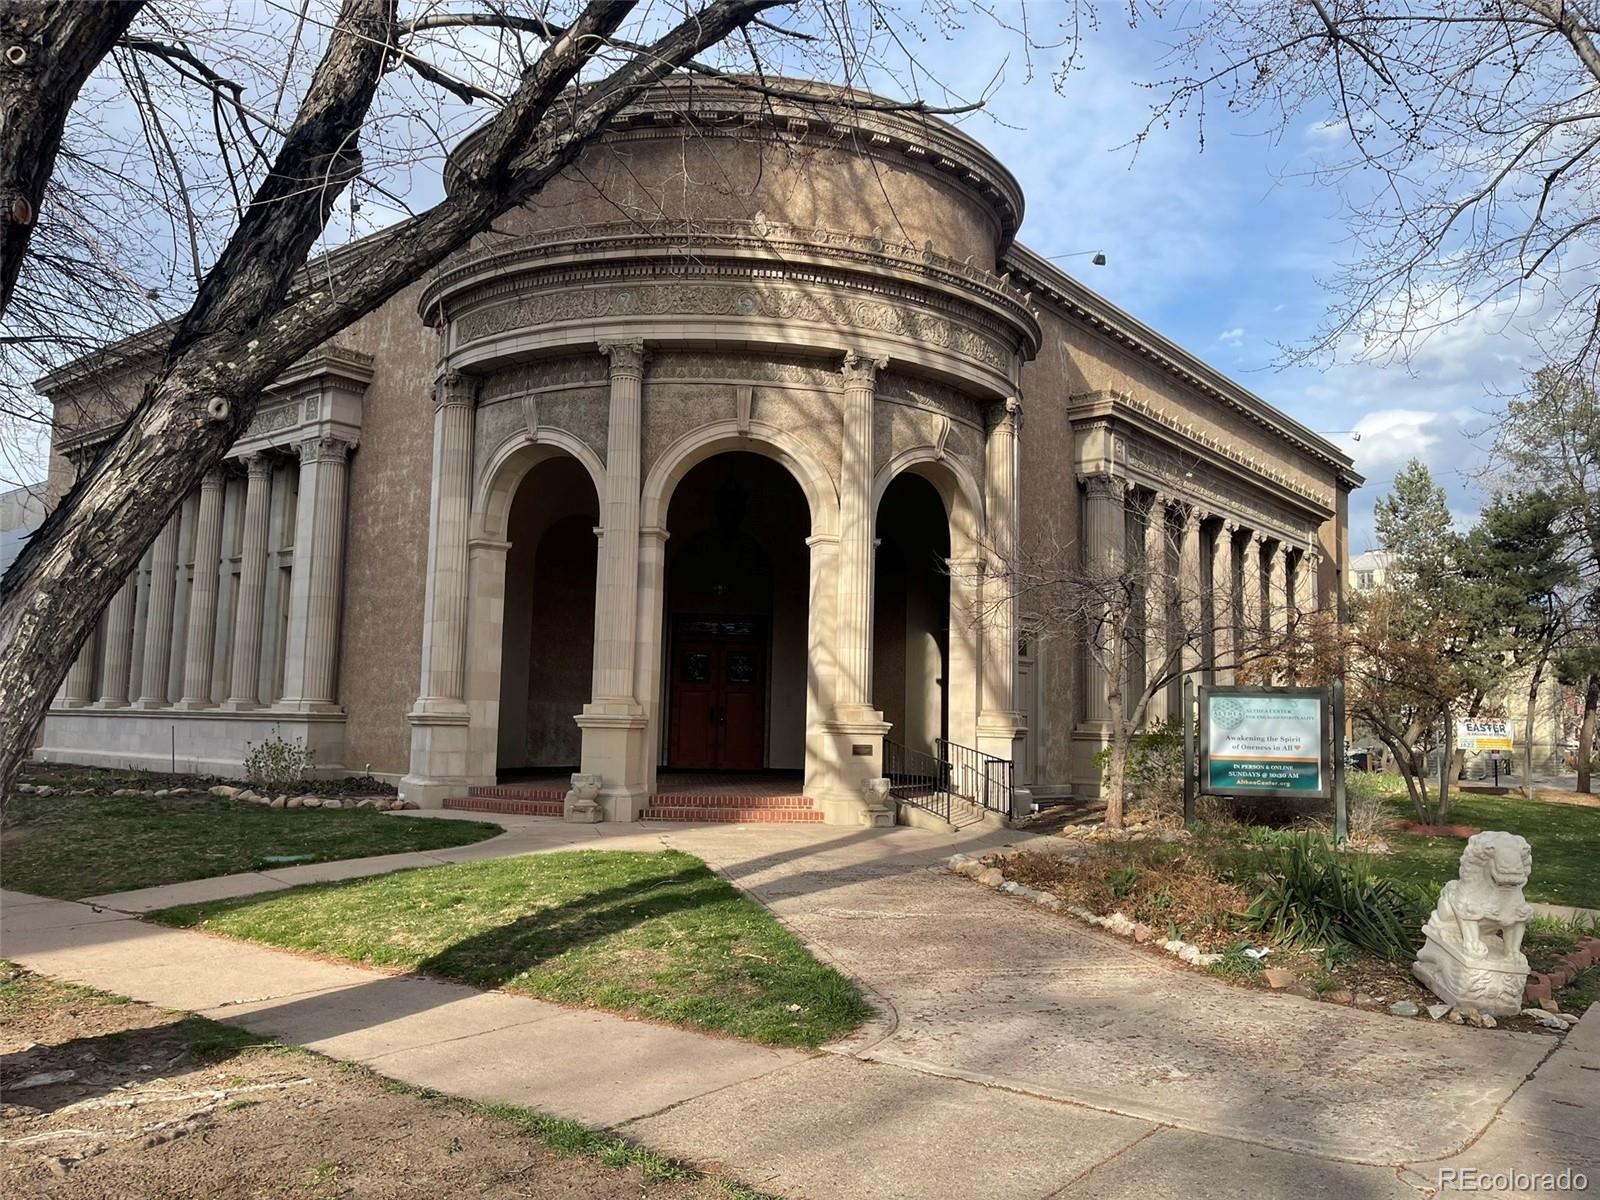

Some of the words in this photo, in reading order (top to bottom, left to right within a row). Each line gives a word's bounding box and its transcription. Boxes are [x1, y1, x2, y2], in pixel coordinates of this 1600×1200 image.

[1466, 723, 1506, 733] EASTER
[1225, 735, 1265, 743] Awakening
[1280, 736, 1301, 744] Spirit
